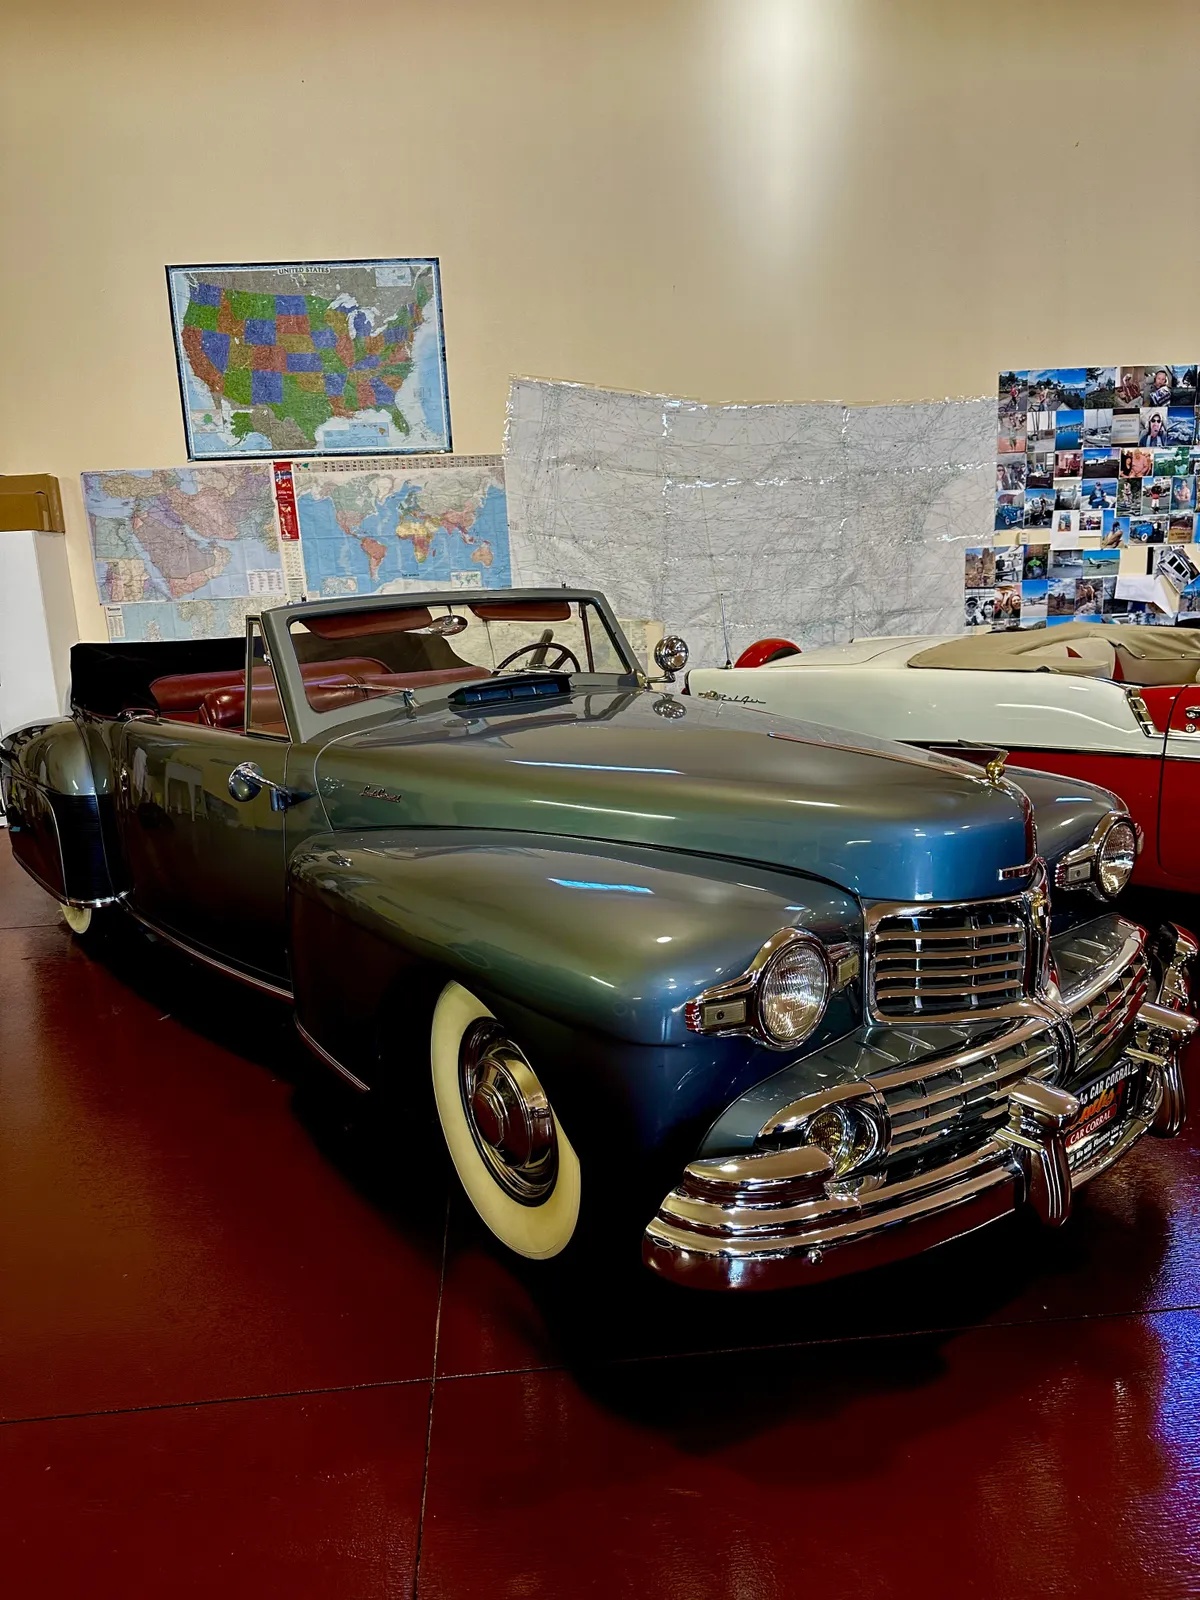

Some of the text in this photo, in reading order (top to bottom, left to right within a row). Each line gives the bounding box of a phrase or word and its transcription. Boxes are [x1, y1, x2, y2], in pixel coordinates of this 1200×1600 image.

[1090, 1080, 1104, 1099] CAR
[1105, 1063, 1131, 1089] CORRAL
[1070, 1110, 1111, 1144] CAR CORRAL
